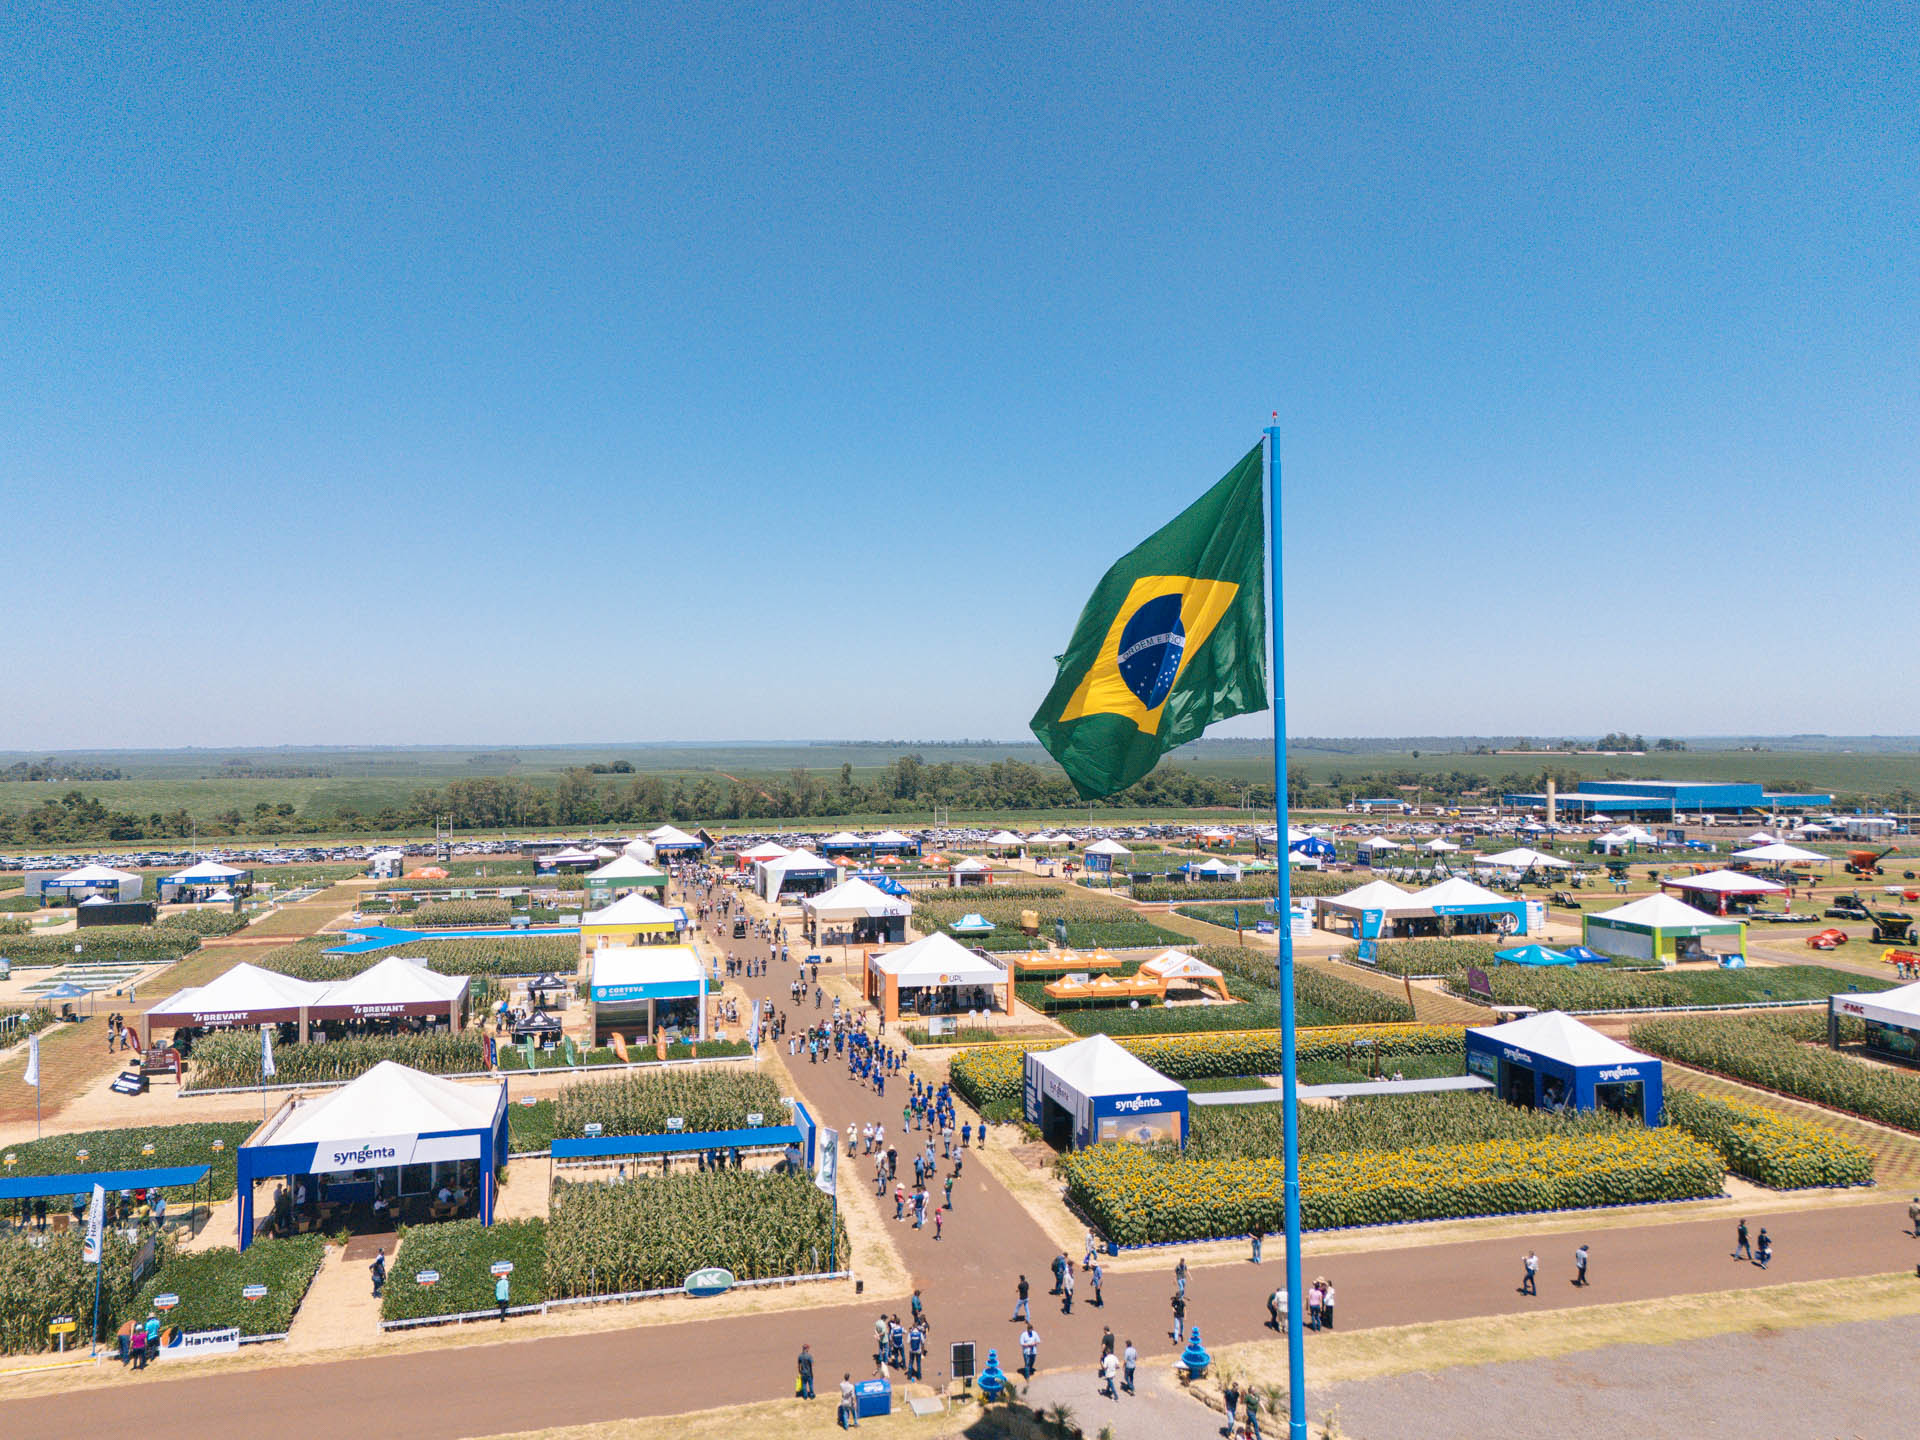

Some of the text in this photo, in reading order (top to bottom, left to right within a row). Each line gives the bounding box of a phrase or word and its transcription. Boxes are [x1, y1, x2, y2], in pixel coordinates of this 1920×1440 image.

[1123, 638, 1155, 660] ORDEM
[1503, 1048, 1532, 1063] syngenta
[1599, 1065, 1640, 1080] syngenta
[1115, 1096, 1162, 1112] syngenta
[333, 1145, 395, 1165] syngenta
[697, 1272, 722, 1287] NK
[185, 1332, 238, 1347] Harvest
